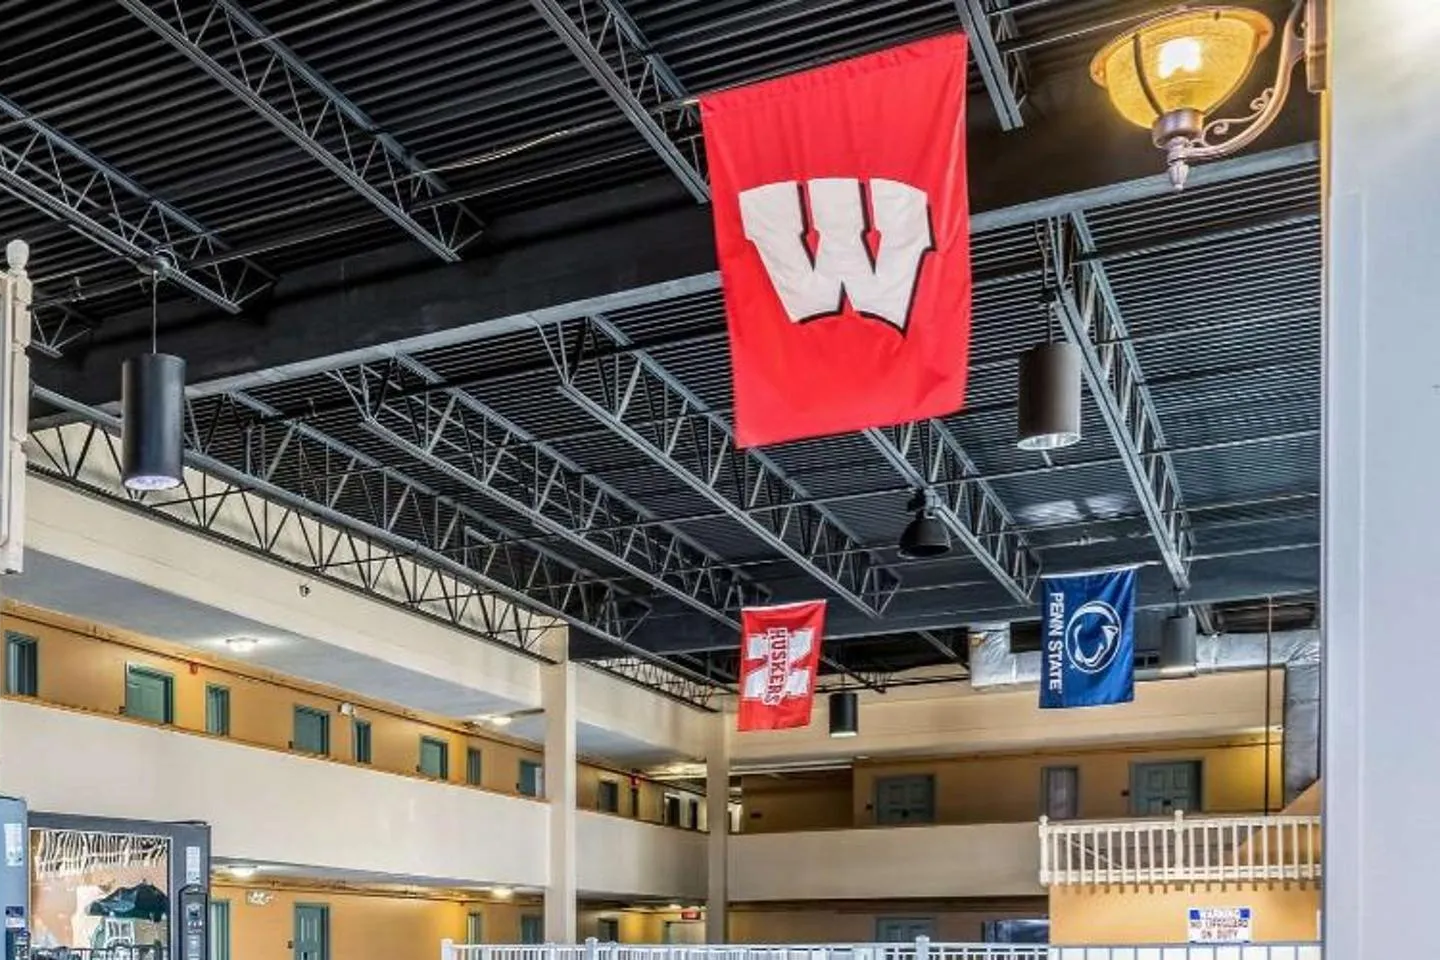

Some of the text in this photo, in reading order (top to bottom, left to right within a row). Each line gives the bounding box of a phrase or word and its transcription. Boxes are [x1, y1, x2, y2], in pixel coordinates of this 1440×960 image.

[738, 176, 937, 338] W
[763, 628, 788, 704] HUSKERS
[1047, 592, 1065, 691] PENN STATE
